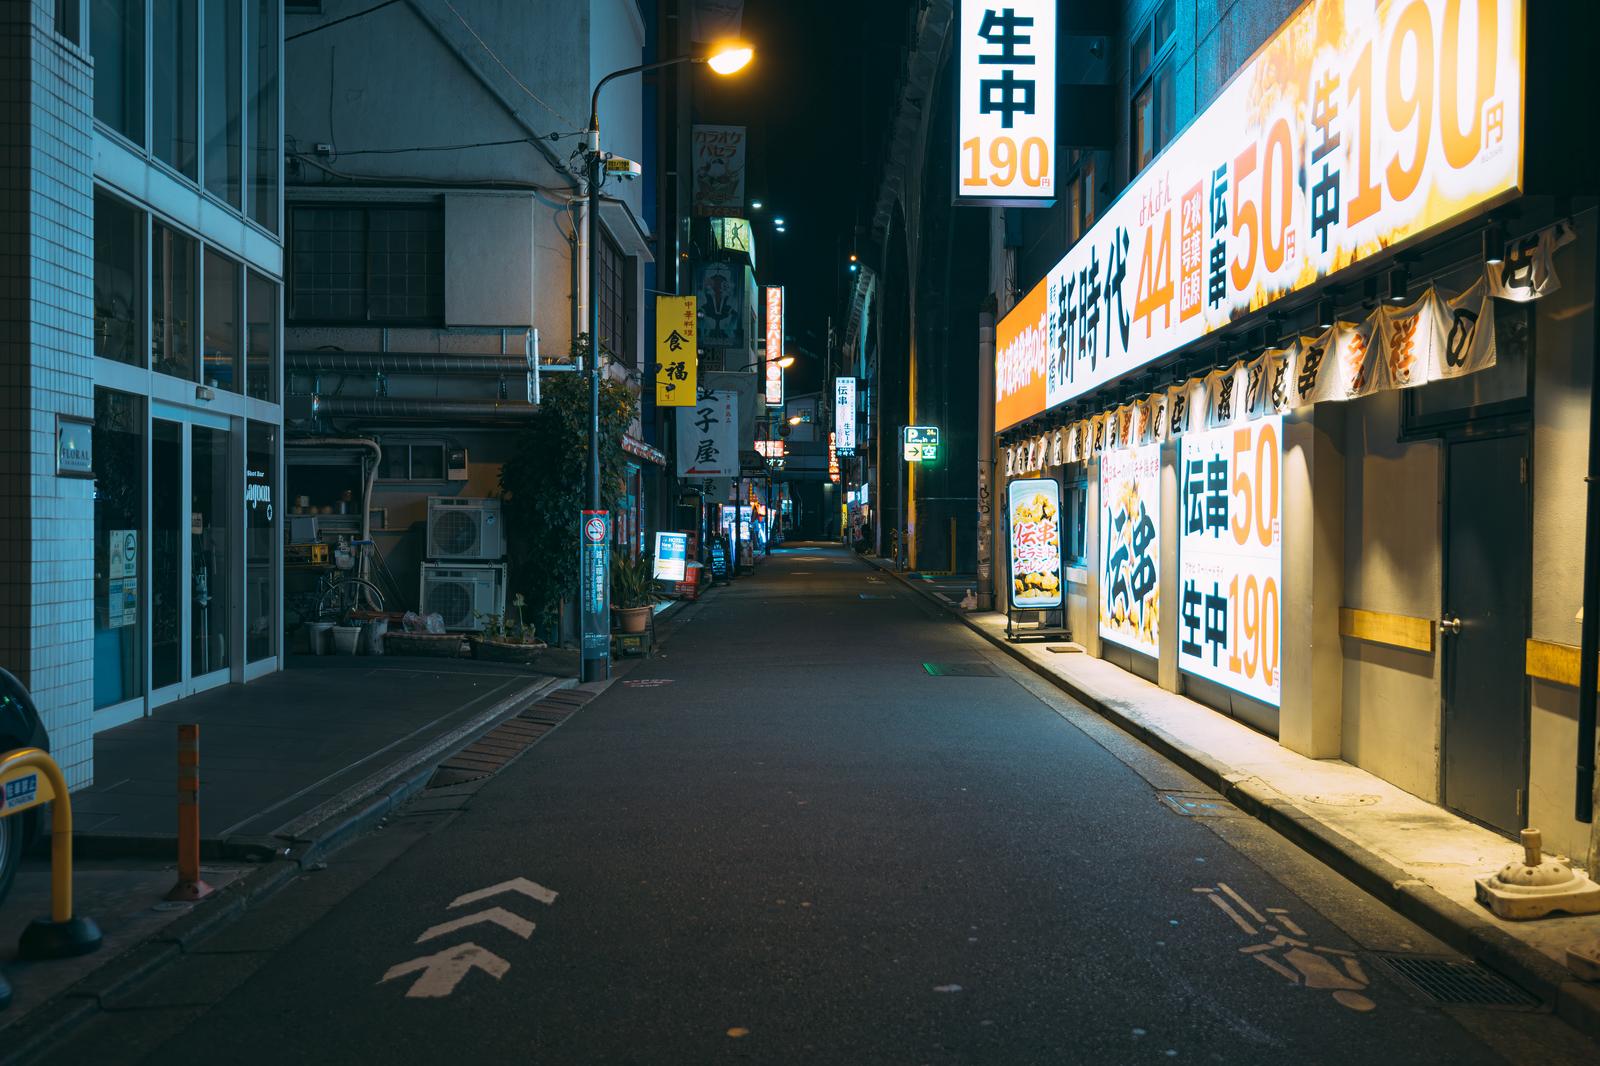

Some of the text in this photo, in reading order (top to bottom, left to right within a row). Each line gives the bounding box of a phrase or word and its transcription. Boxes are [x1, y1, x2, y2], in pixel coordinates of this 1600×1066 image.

[978, 8, 1036, 128] 生中
[695, 131, 742, 144] カラオケ
[700, 145, 736, 157] パセラ
[1311, 67, 1340, 252] 生中
[1133, 208, 1174, 339] 44
[1181, 199, 1191, 311] 2号店
[1191, 192, 1201, 306] 秋葉原
[1209, 162, 1228, 310] 伝串
[684, 301, 694, 336] 中華料理
[1058, 226, 1130, 386] 新時代
[664, 330, 689, 380] 食福
[838, 387, 848, 405] 伝串
[62, 448, 89, 460] FLORAL
[922, 446, 936, 459] 空
[1016, 520, 1055, 546] 伝串
[1183, 453, 1228, 539] 伝串
[1106, 501, 1156, 618] 伝串
[1181, 580, 1228, 667] 生中
